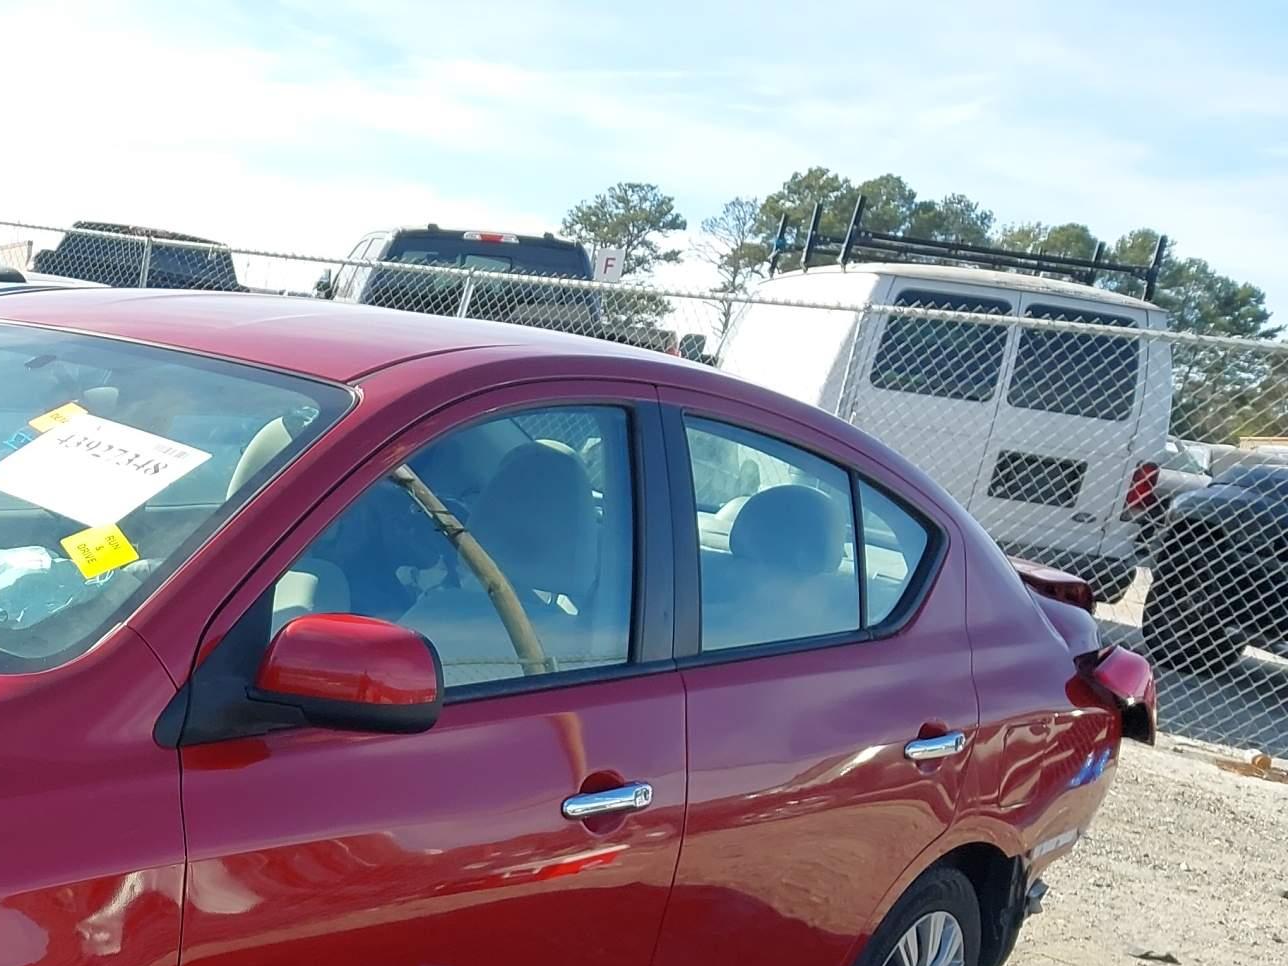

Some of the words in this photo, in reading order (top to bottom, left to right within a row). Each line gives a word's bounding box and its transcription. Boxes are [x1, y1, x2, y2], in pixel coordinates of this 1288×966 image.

[603, 257, 616, 274] F
[105, 535, 121, 551] RUN
[76, 543, 97, 565] DRIVE
